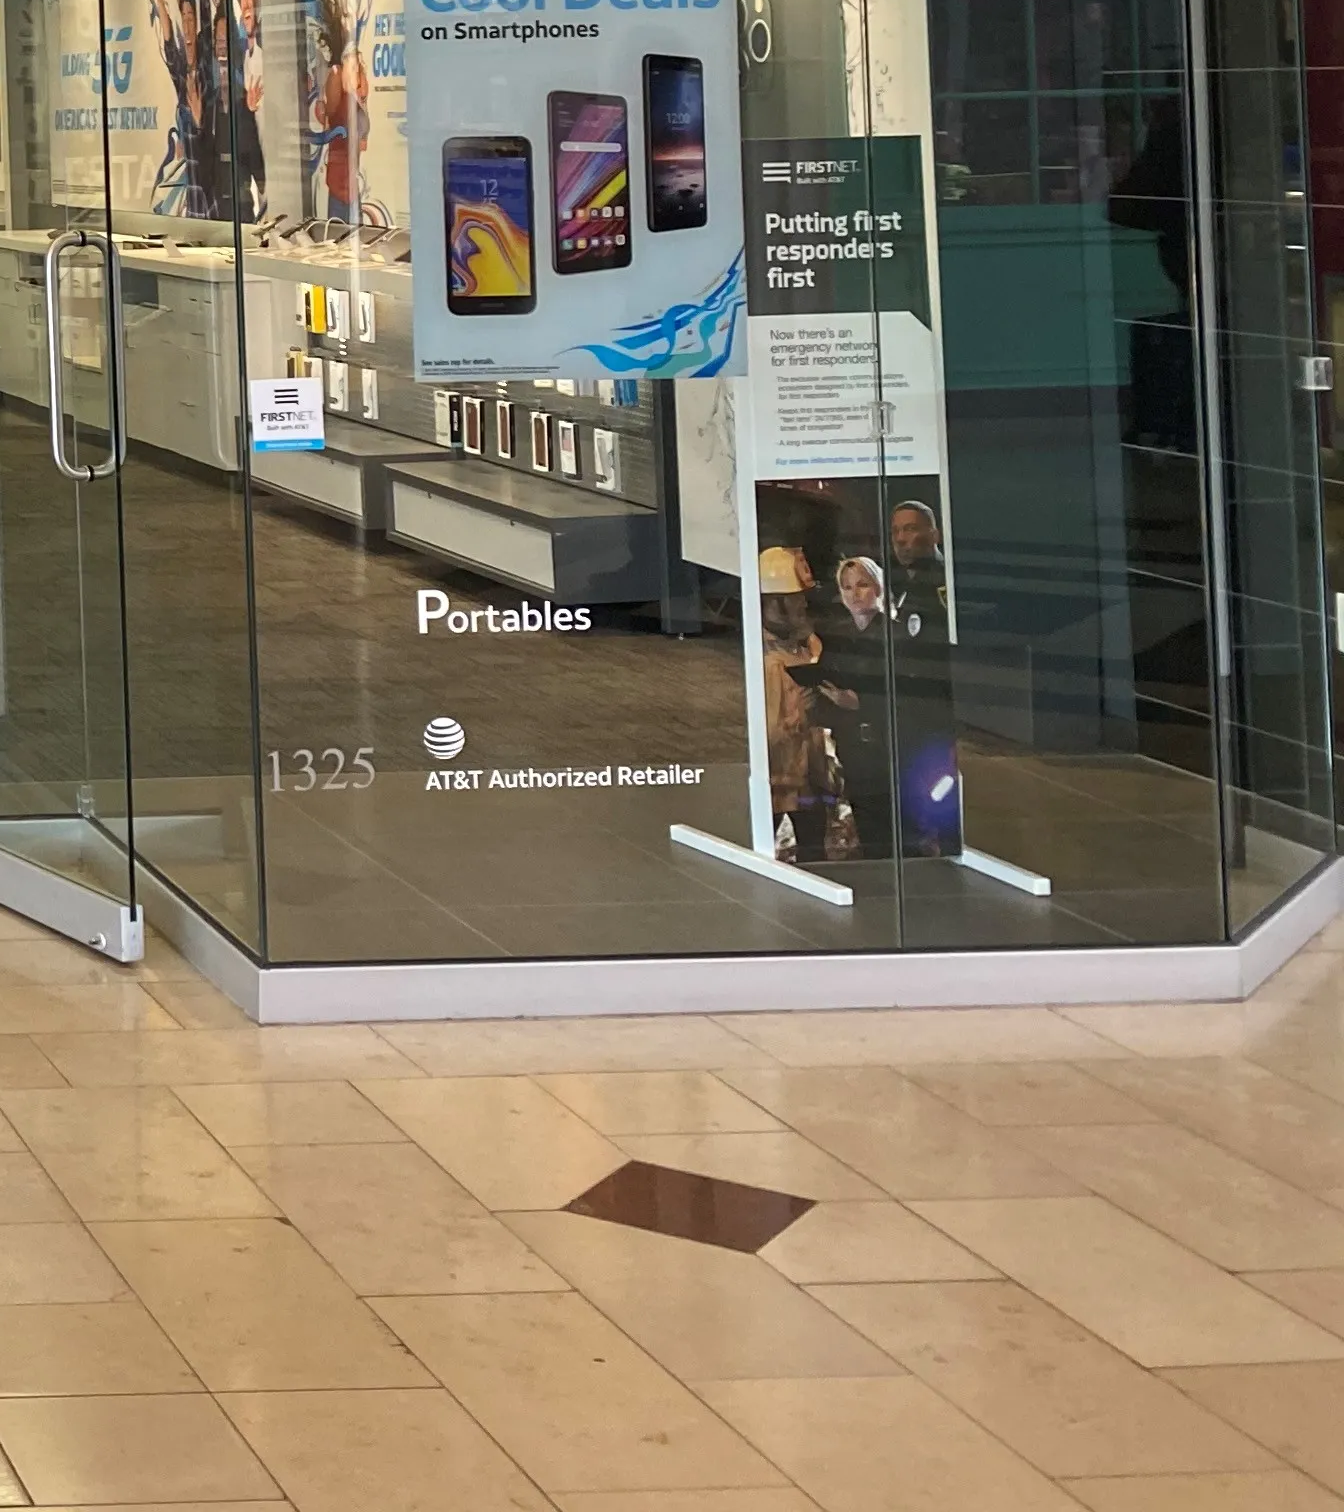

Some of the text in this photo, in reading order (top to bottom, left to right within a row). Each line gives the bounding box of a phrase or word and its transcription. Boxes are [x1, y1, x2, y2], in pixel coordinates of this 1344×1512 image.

[420, 24, 448, 40] on
[455, 20, 600, 43] Smartphones
[666, 113, 691, 124] 12:00
[796, 160, 858, 174] FIRSTNET
[480, 179, 499, 196] 12
[765, 210, 903, 237] Putting first
[767, 238, 894, 264] responders
[767, 267, 816, 289] first
[770, 328, 852, 340] Now there's an
[770, 341, 878, 355] emergency networ
[771, 355, 785, 366] for
[789, 354, 810, 366] first
[260, 410, 315, 422] FIRSTNET
[416, 589, 592, 634] Portables
[267, 746, 377, 792] 1325
[425, 764, 705, 791] AT&T Authorized Retailer
